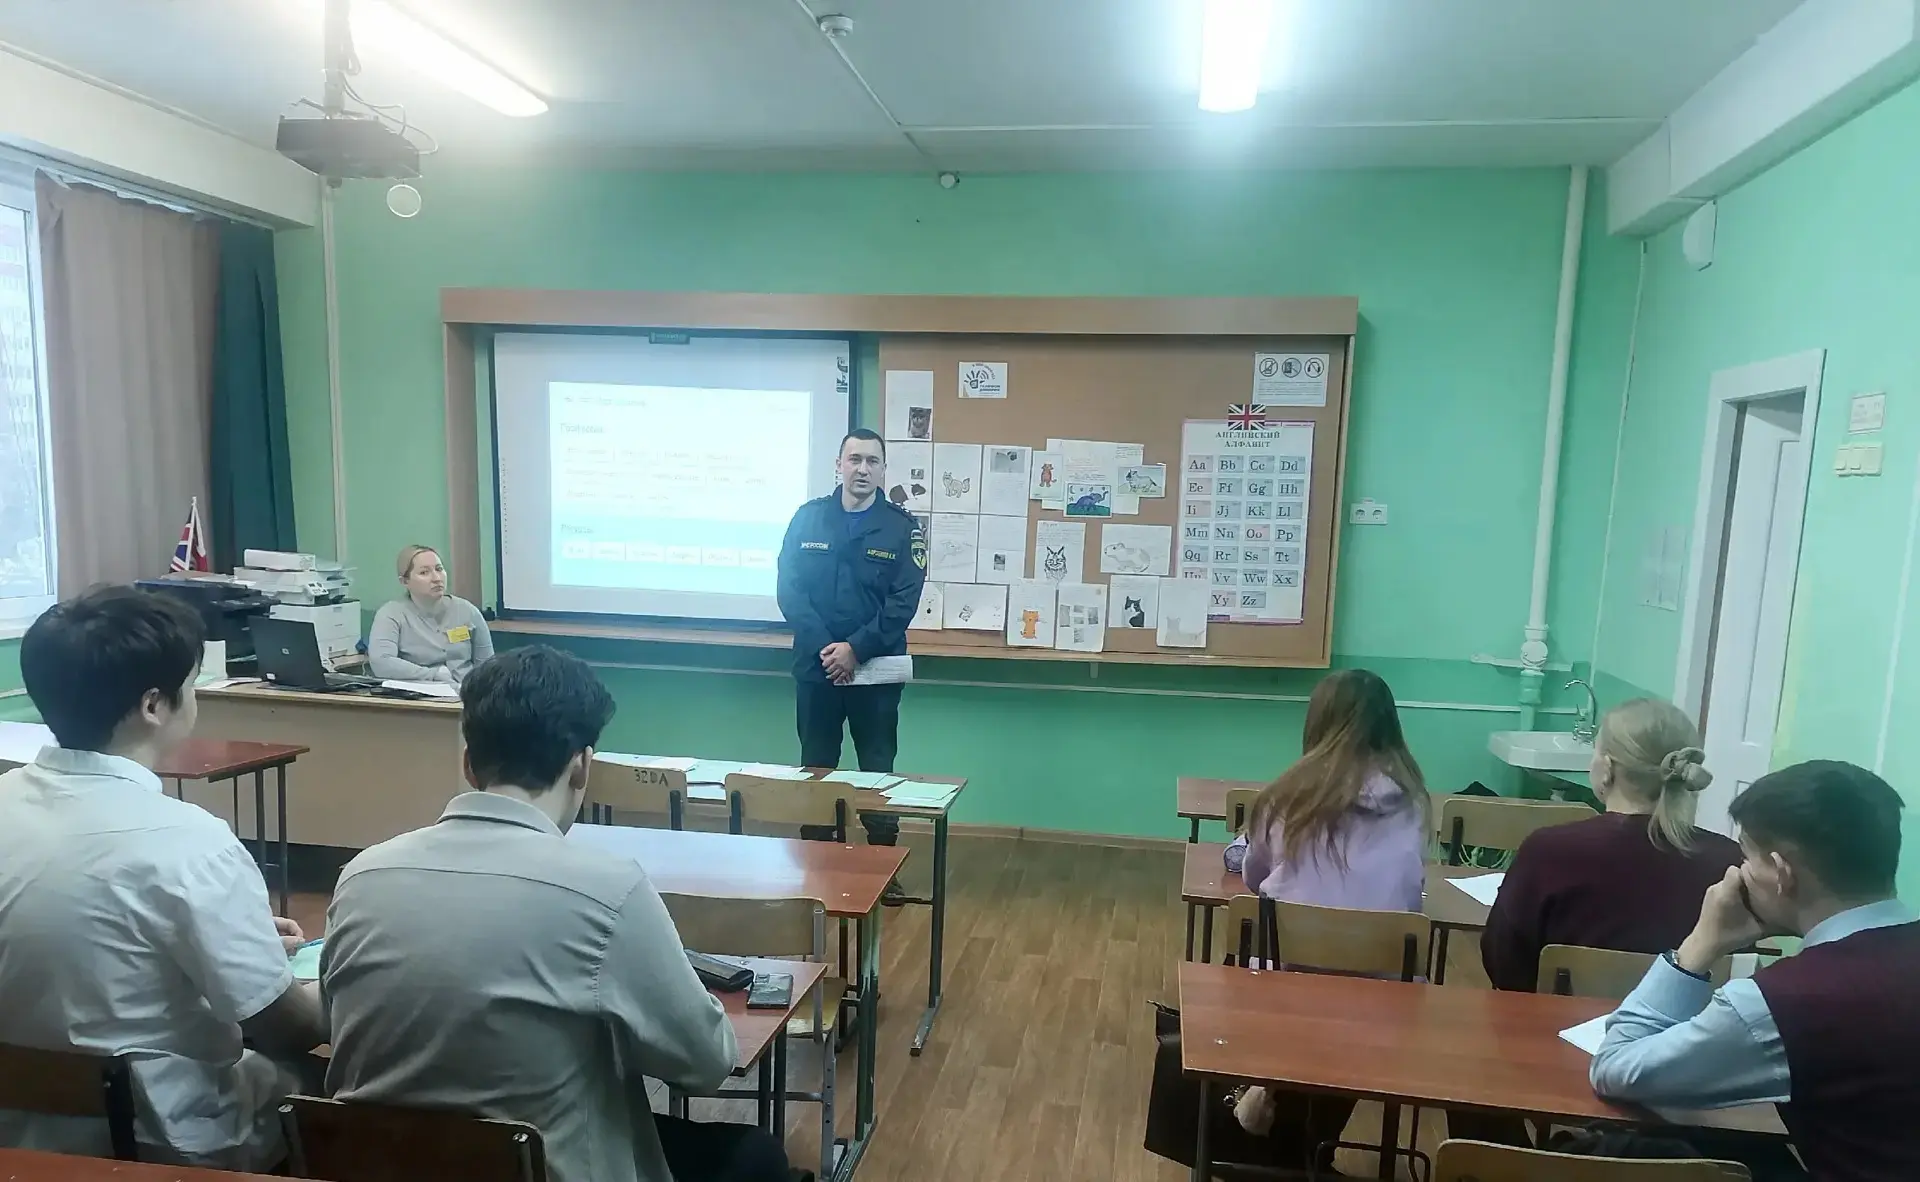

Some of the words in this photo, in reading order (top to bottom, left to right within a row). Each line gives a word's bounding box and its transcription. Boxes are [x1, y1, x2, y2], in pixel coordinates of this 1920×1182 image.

[1215, 431, 1281, 439] АНГЛИЙСКИЙ
[1189, 460, 1206, 470] Aa
[1220, 460, 1236, 470] Bb
[1250, 460, 1265, 471] Cc
[1281, 460, 1298, 471] Dd
[1189, 483, 1203, 492] Ee
[1218, 482, 1233, 493] Ff
[1248, 483, 1267, 496] Gg
[1280, 484, 1298, 494] Hh
[1187, 505, 1197, 515] Ii
[1217, 505, 1229, 517] Jj
[1247, 506, 1265, 516] Kk
[1277, 506, 1291, 517] Ll
[1186, 527, 1208, 538] Mm
[1216, 528, 1234, 538] Nn
[1246, 529, 1262, 539] Oo
[1277, 529, 1293, 541] Pp
[1185, 549, 1201, 562] Qq
[1215, 550, 1231, 560] Rr
[1244, 551, 1259, 561] Ss
[1275, 552, 1290, 562] Tt
[1214, 572, 1230, 583] Vv
[1244, 573, 1266, 583] Ww
[1274, 574, 1292, 584] Xx
[1212, 594, 1229, 606] Yy
[1242, 595, 1257, 606] Zz
